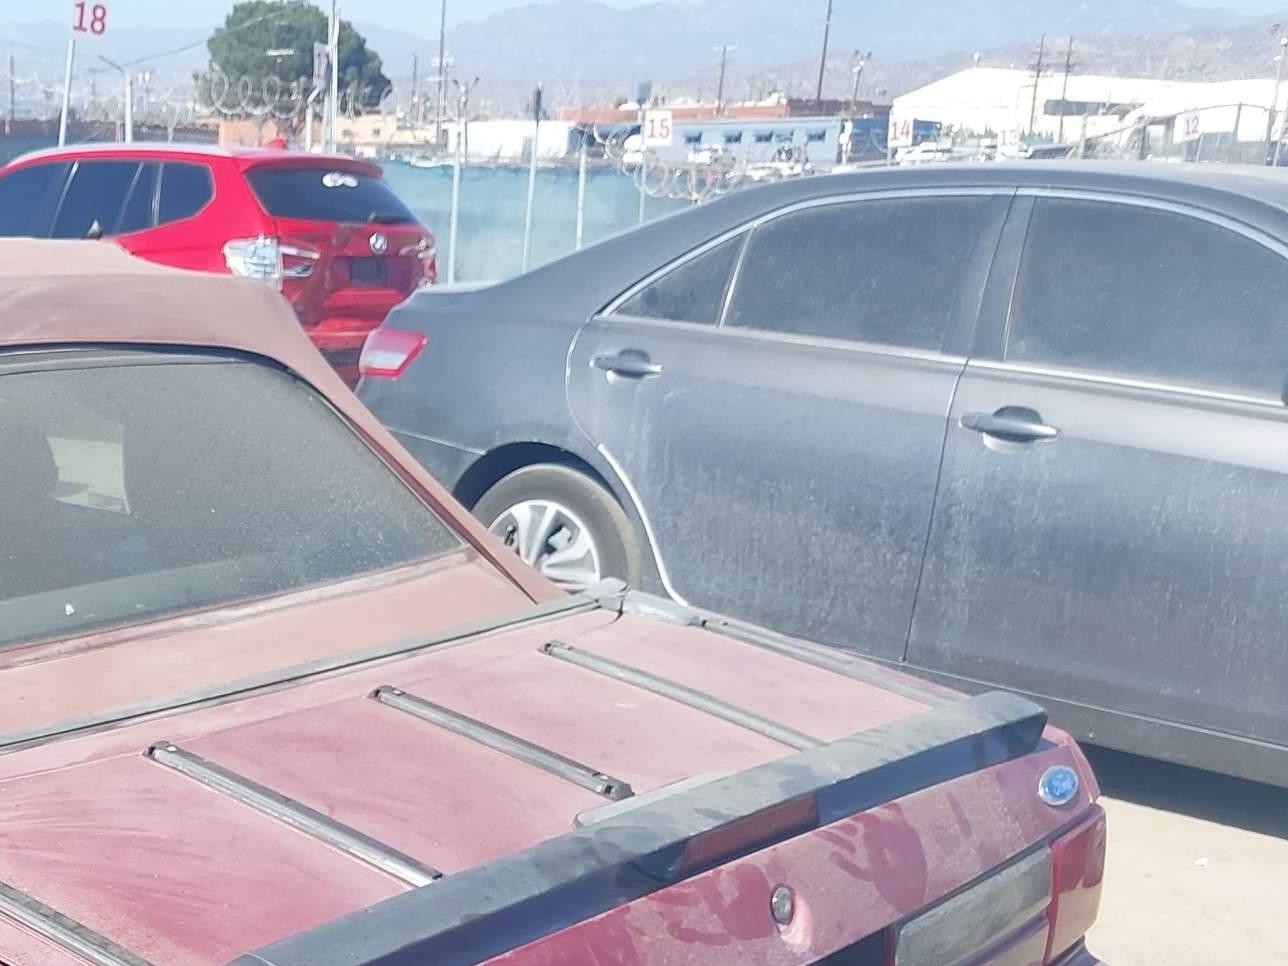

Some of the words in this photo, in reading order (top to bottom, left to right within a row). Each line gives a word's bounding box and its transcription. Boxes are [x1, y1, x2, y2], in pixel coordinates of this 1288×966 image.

[73, 2, 106, 35] 18
[647, 118, 670, 138] 15
[891, 120, 910, 141] 14
[1185, 116, 1200, 136] 12
